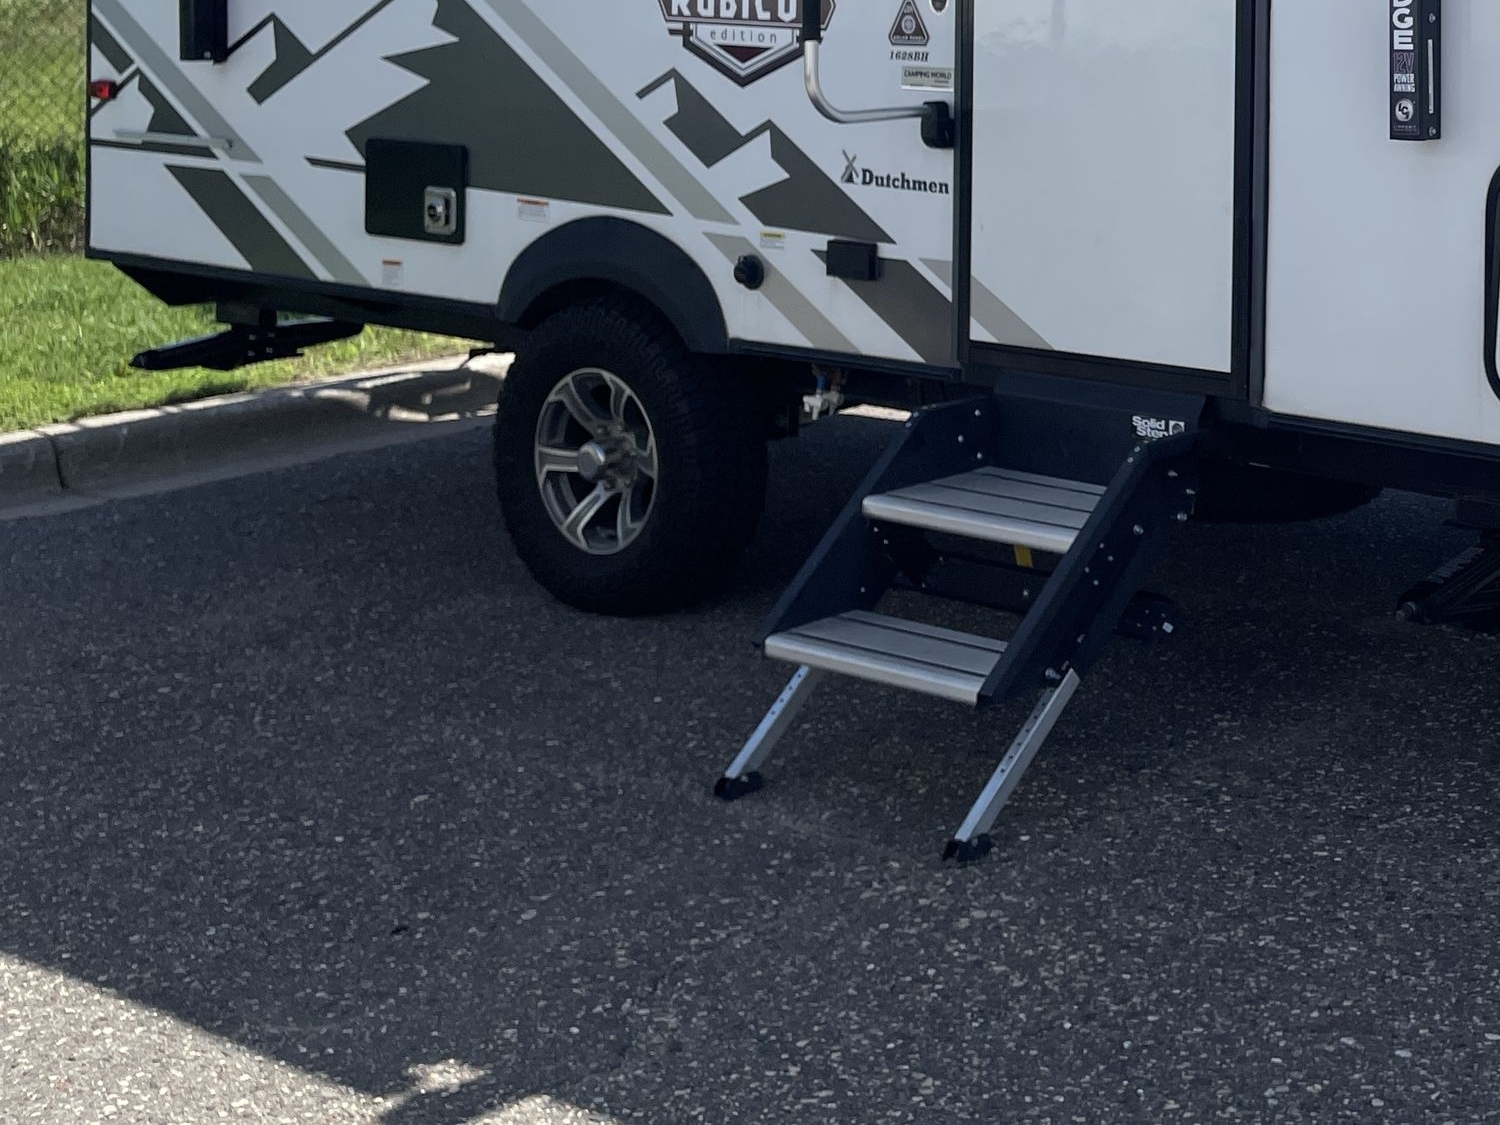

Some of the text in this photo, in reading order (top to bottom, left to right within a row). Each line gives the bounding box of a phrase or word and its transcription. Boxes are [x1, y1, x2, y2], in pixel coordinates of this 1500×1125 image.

[710, 29, 778, 45] edition
[889, 50, 929, 63] 1628BH
[1393, 74, 1415, 83] POWER
[861, 169, 950, 195] Dutchmen
[1132, 415, 1165, 430] Solid
